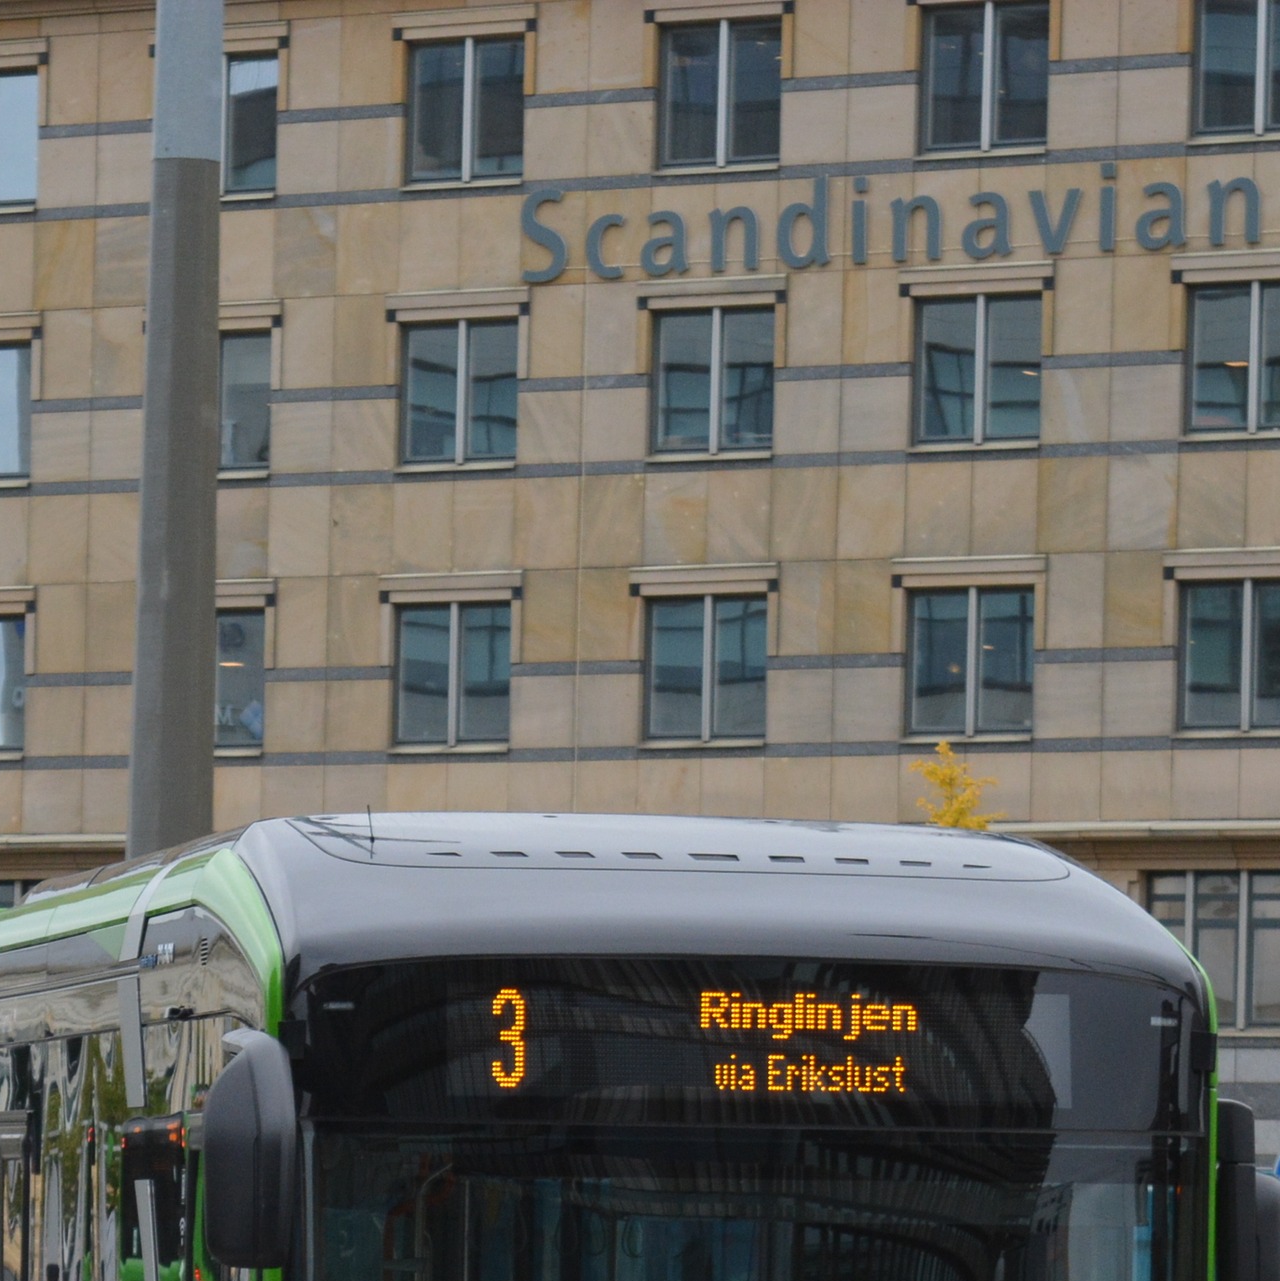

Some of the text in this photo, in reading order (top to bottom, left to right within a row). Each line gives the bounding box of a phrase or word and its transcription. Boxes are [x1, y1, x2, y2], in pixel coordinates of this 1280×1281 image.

[520, 161, 1261, 284] Scandinavian
[491, 988, 525, 1088] 3
[700, 991, 918, 1040] Ringlinjen
[714, 1053, 906, 1093] via Erikslust
